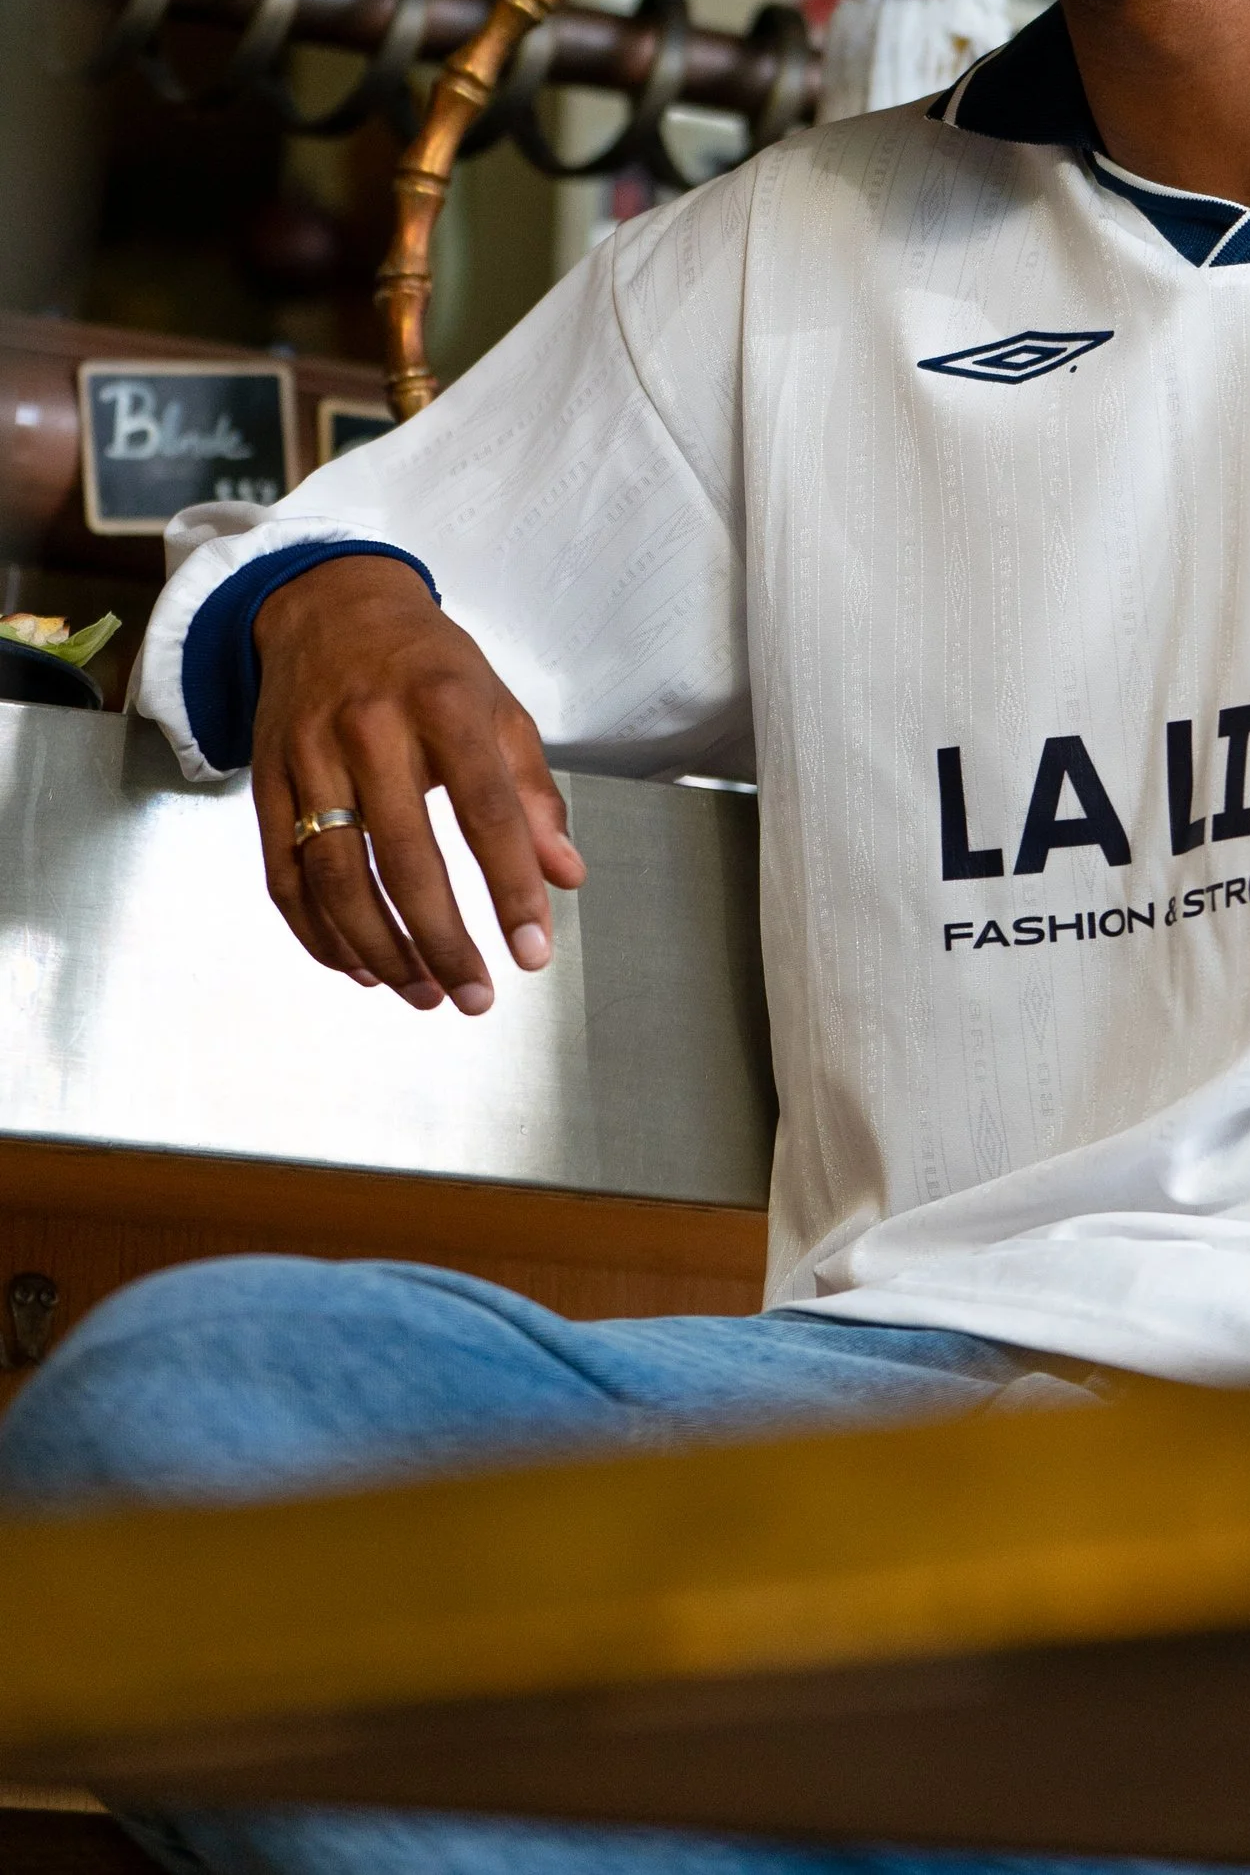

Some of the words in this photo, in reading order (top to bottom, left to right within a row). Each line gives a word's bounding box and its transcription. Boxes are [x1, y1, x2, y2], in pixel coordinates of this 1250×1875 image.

[936, 734, 1133, 882] LA
[943, 901, 1156, 953] FASHION
[1163, 895, 1179, 927] &
